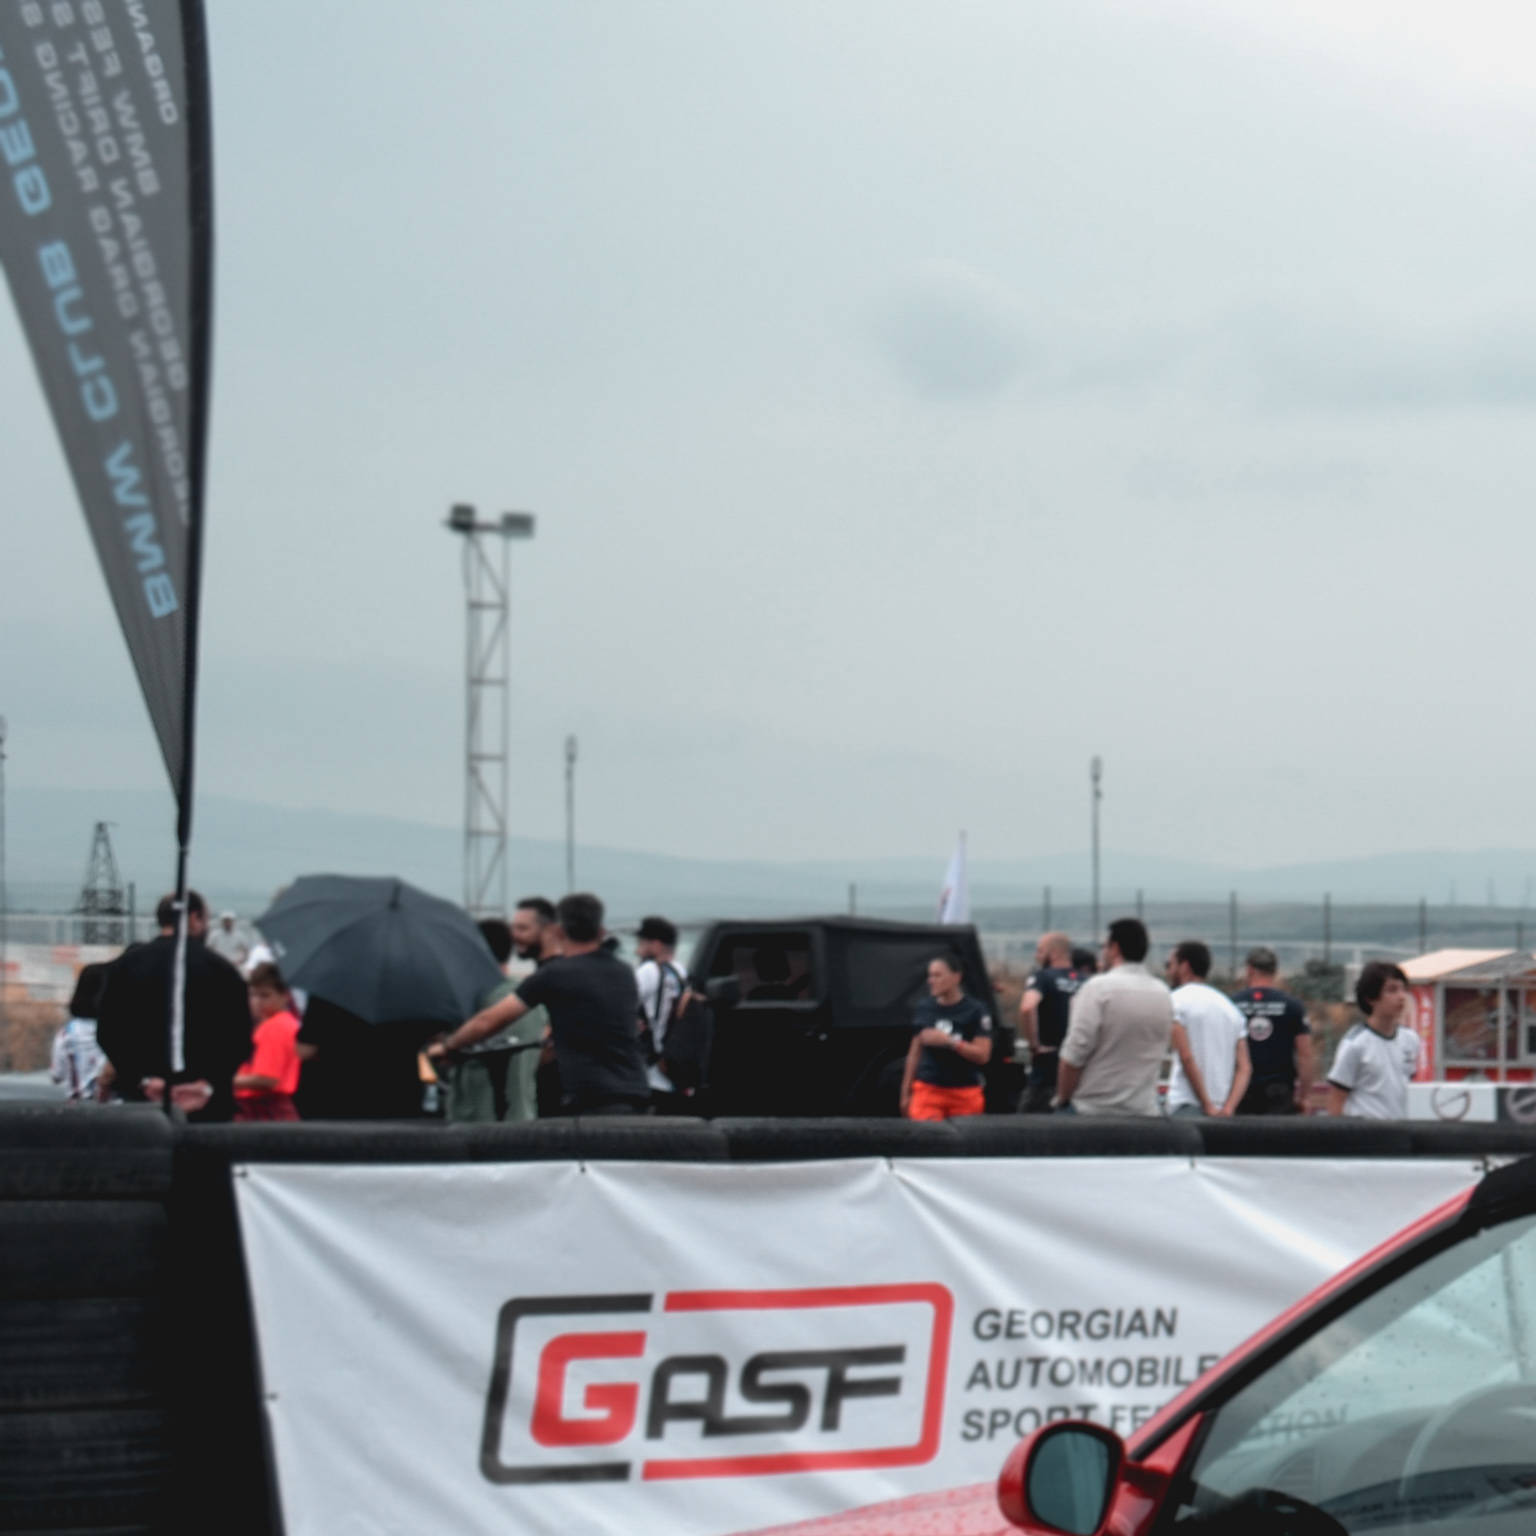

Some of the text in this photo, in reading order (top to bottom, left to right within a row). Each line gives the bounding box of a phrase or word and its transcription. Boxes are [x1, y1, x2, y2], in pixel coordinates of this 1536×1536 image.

[973, 1308, 1178, 1341] GEORGIAN
[530, 1330, 906, 1447] GASF
[965, 1354, 1220, 1391] AUTOMOBILE
